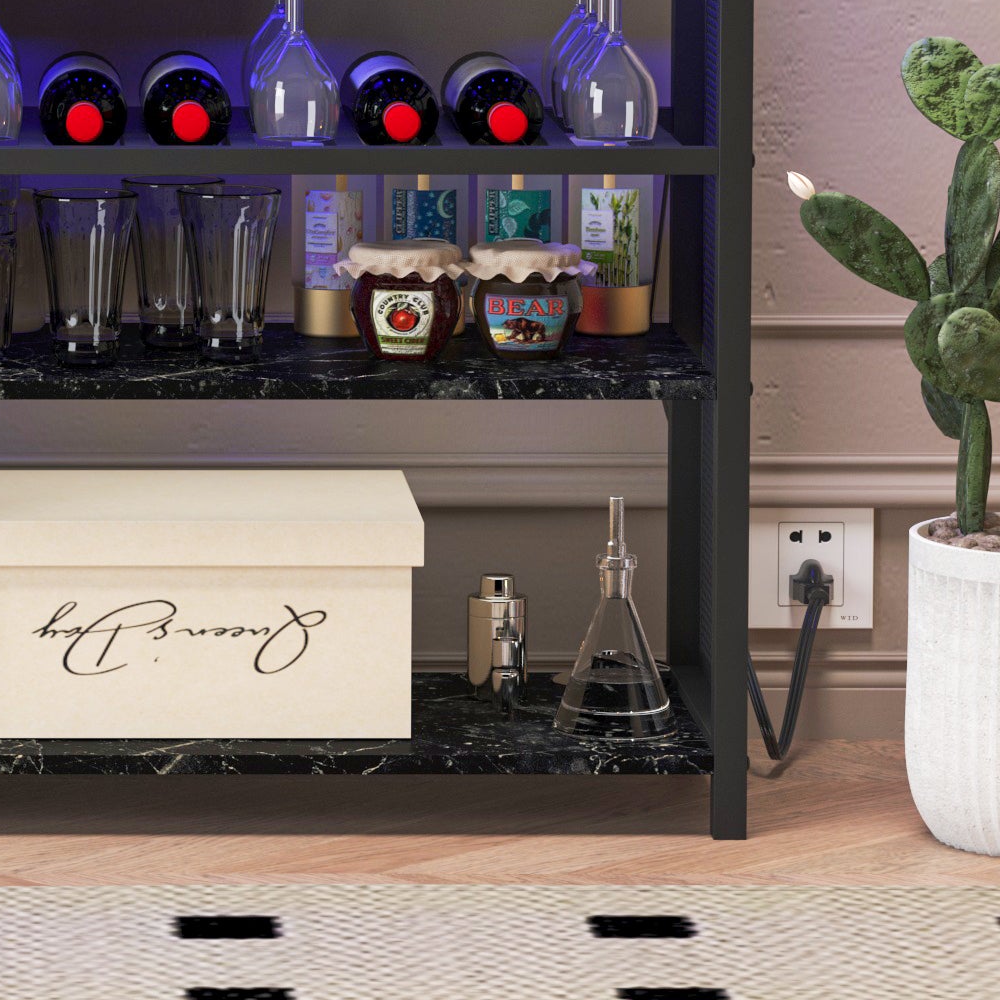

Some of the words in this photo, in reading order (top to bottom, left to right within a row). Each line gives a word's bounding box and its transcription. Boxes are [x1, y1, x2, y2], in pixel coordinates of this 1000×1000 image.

[378, 294, 410, 315] COUNTRY
[413, 297, 429, 316] CLUB
[488, 298, 565, 317] BEAR
